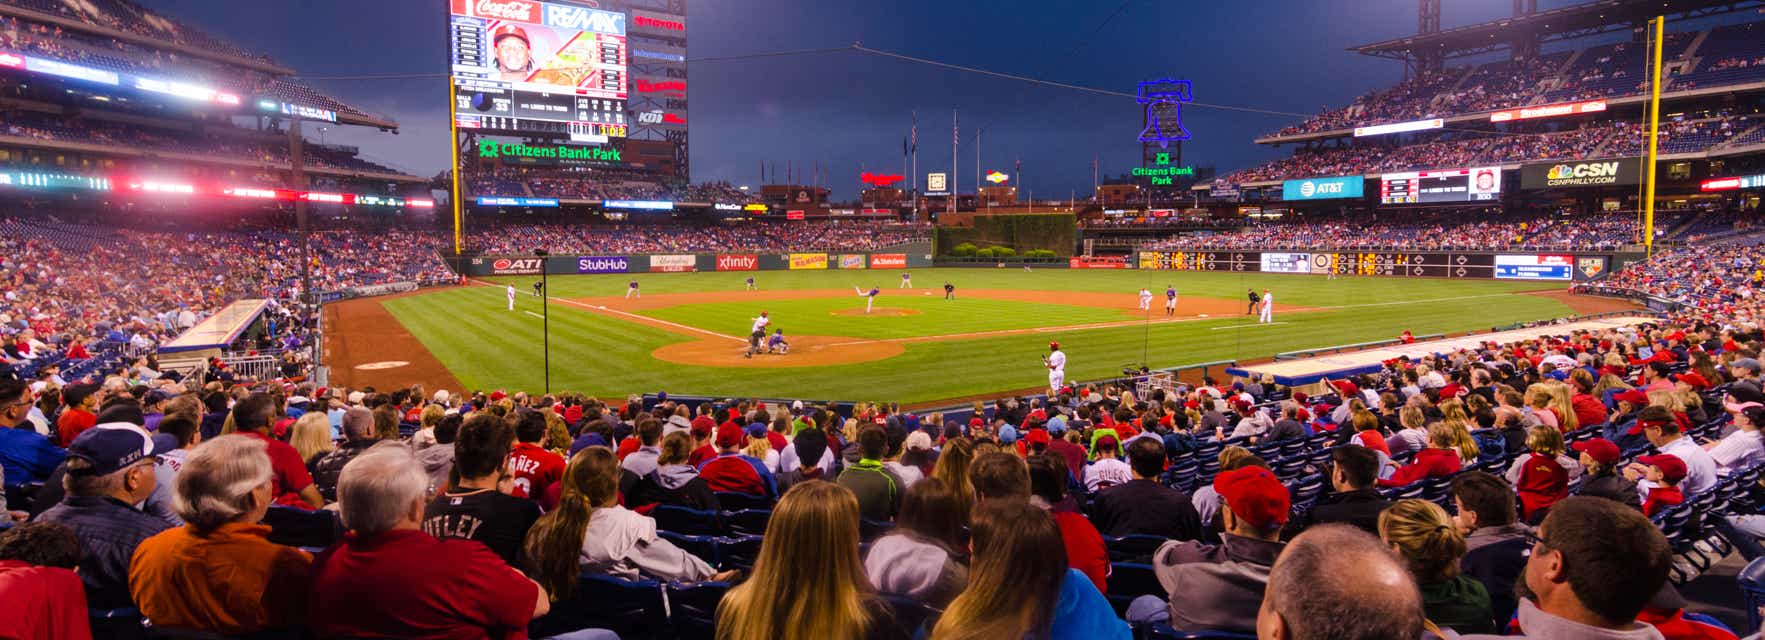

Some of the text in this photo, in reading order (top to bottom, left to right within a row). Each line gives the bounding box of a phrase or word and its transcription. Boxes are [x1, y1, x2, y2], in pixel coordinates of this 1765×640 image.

[476, 0, 533, 20] Coca-Cola
[547, 5, 619, 33] RE/MAX
[643, 17, 684, 31] TOYOTA
[501, 143, 621, 161] Citizens Bank Park
[1132, 166, 1193, 176] Citizens Bank
[1573, 162, 1619, 178] CSN
[1152, 176, 1173, 185] Park
[1547, 176, 1616, 186] CSNPHILLY.COM
[1316, 183, 1344, 194] AT&T
[510, 259, 543, 269] ATI
[579, 258, 627, 271] StubHub
[719, 256, 755, 270] xfinity
